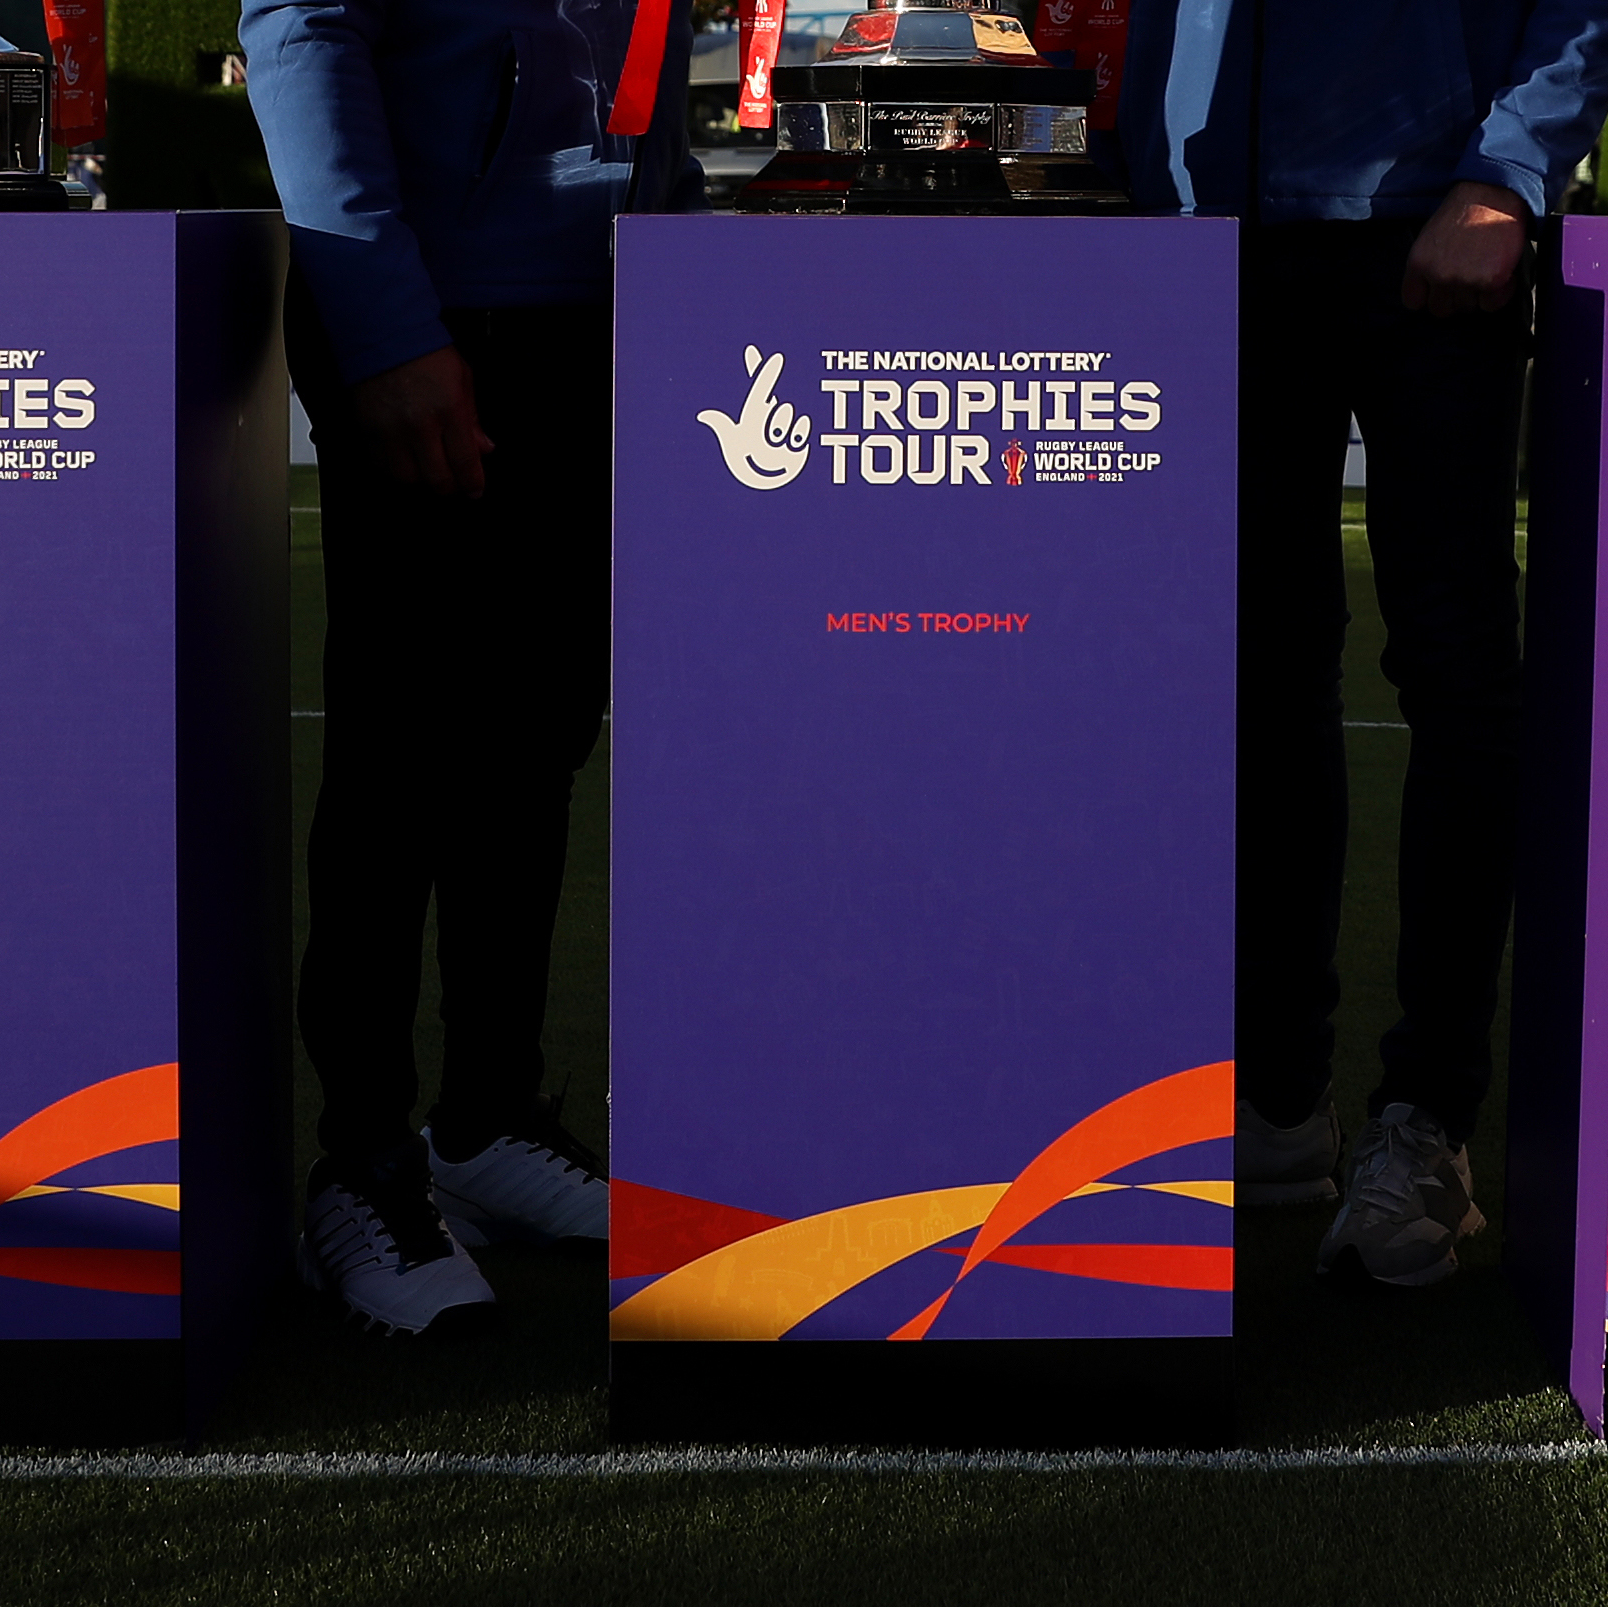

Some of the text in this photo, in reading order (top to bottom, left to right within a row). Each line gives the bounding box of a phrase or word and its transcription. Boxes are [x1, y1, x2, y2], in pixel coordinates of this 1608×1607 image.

[958, 108, 992, 125] Trophy
[894, 128, 928, 136] RUGBY
[902, 137, 937, 145] WORLD
[821, 350, 1112, 372] THE NATIONAL LOTTERY
[820, 379, 1161, 431] TROPHIES
[12, 439, 58, 450] LEAGUE
[1035, 440, 1124, 452] RUGBY LEAGUE
[51, 451, 95, 469] CUP
[820, 434, 992, 485] TOUR
[1033, 452, 1161, 471] WORLD CUP
[32, 470, 58, 480] 2021
[1035, 472, 1124, 482] ENGLAND 2021
[827, 612, 1030, 633] MEN'S TROPHY
